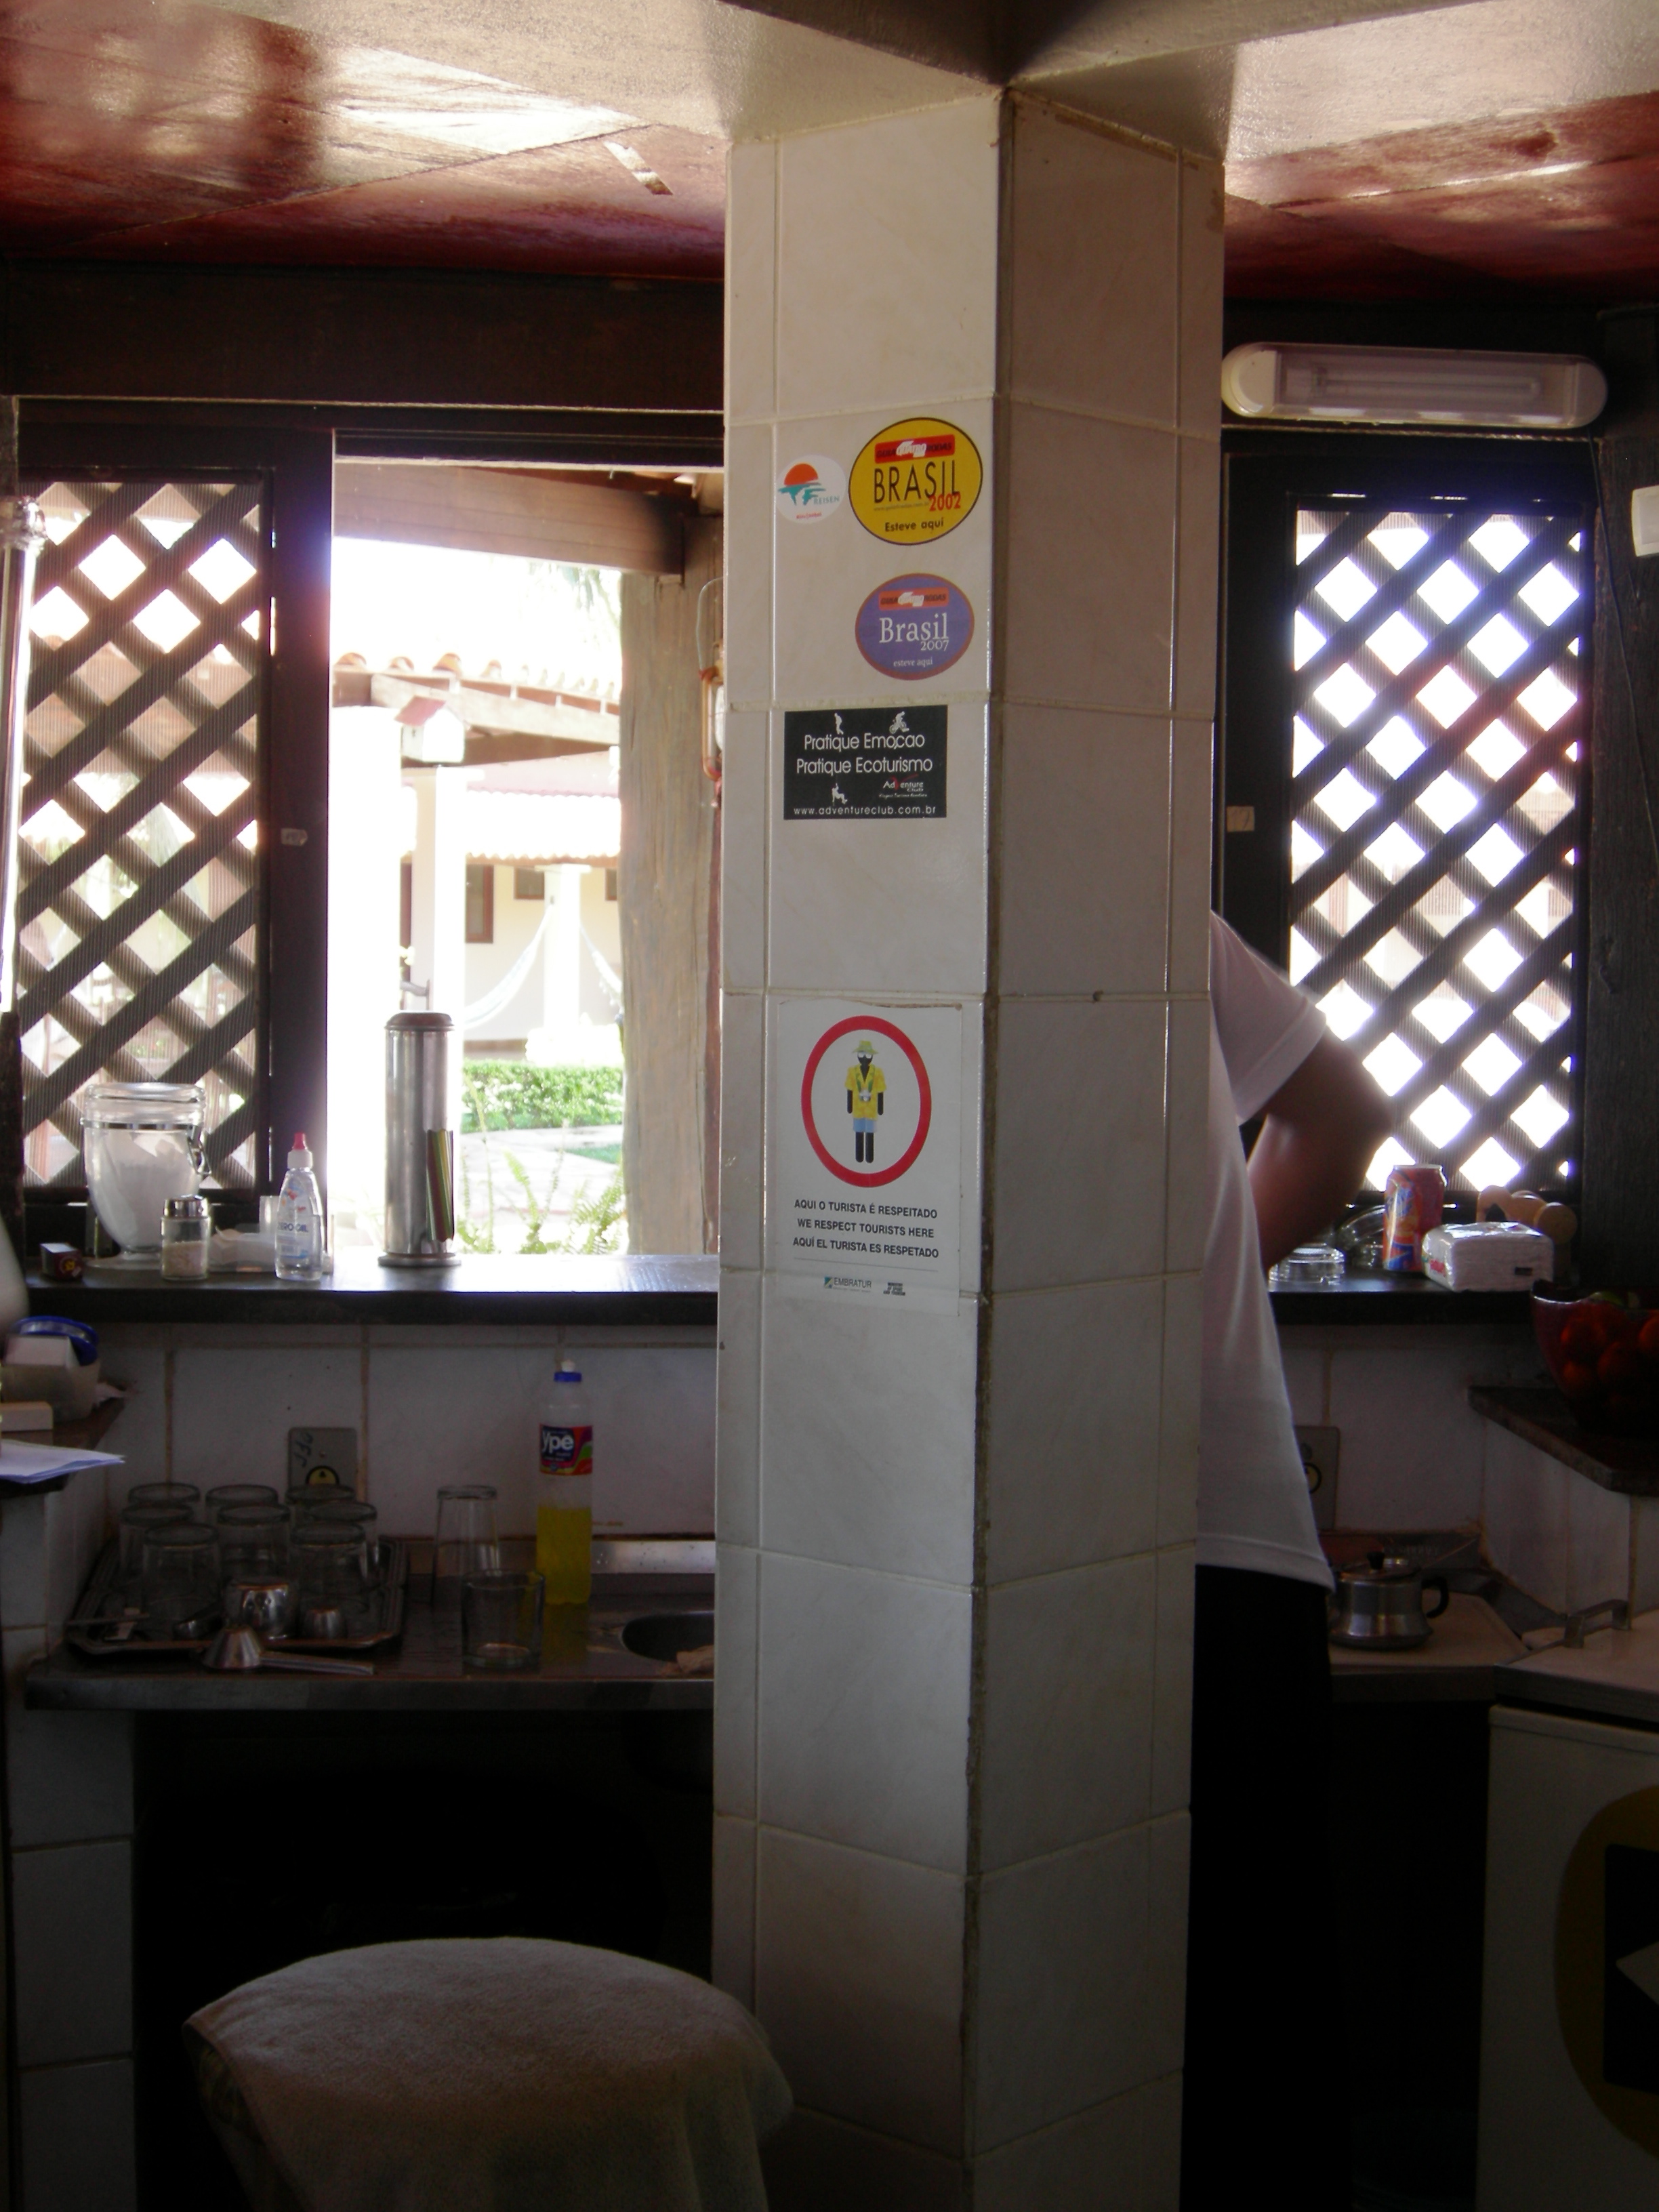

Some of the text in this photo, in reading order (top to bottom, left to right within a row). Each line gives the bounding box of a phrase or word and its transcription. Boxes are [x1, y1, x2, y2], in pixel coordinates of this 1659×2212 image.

[874, 459, 960, 504] BRASIL
[813, 495, 840, 505] REISEN
[929, 493, 961, 512] 2002
[885, 517, 944, 532] Esteve aqui
[879, 612, 949, 643] Brasil
[920, 640, 949, 651] 2007
[893, 657, 933, 668] esteve aqui
[804, 734, 859, 752] Pratique
[796, 757, 933, 777] Pratique Ecoturismo
[794, 805, 937, 815] www.adventureclub.com.br
[794, 1199, 937, 1218] AQUI O TURISTA É RESPEITADO
[797, 1218, 934, 1238] WE RESPECT TOURISTS HERE
[817, 1239, 827, 1248] EL
[830, 1240, 867, 1252] TURISTA
[869, 1244, 881, 1253] ES
[884, 1246, 939, 1258] RESPETADO
[834, 1277, 872, 1288] EMBRATUR
